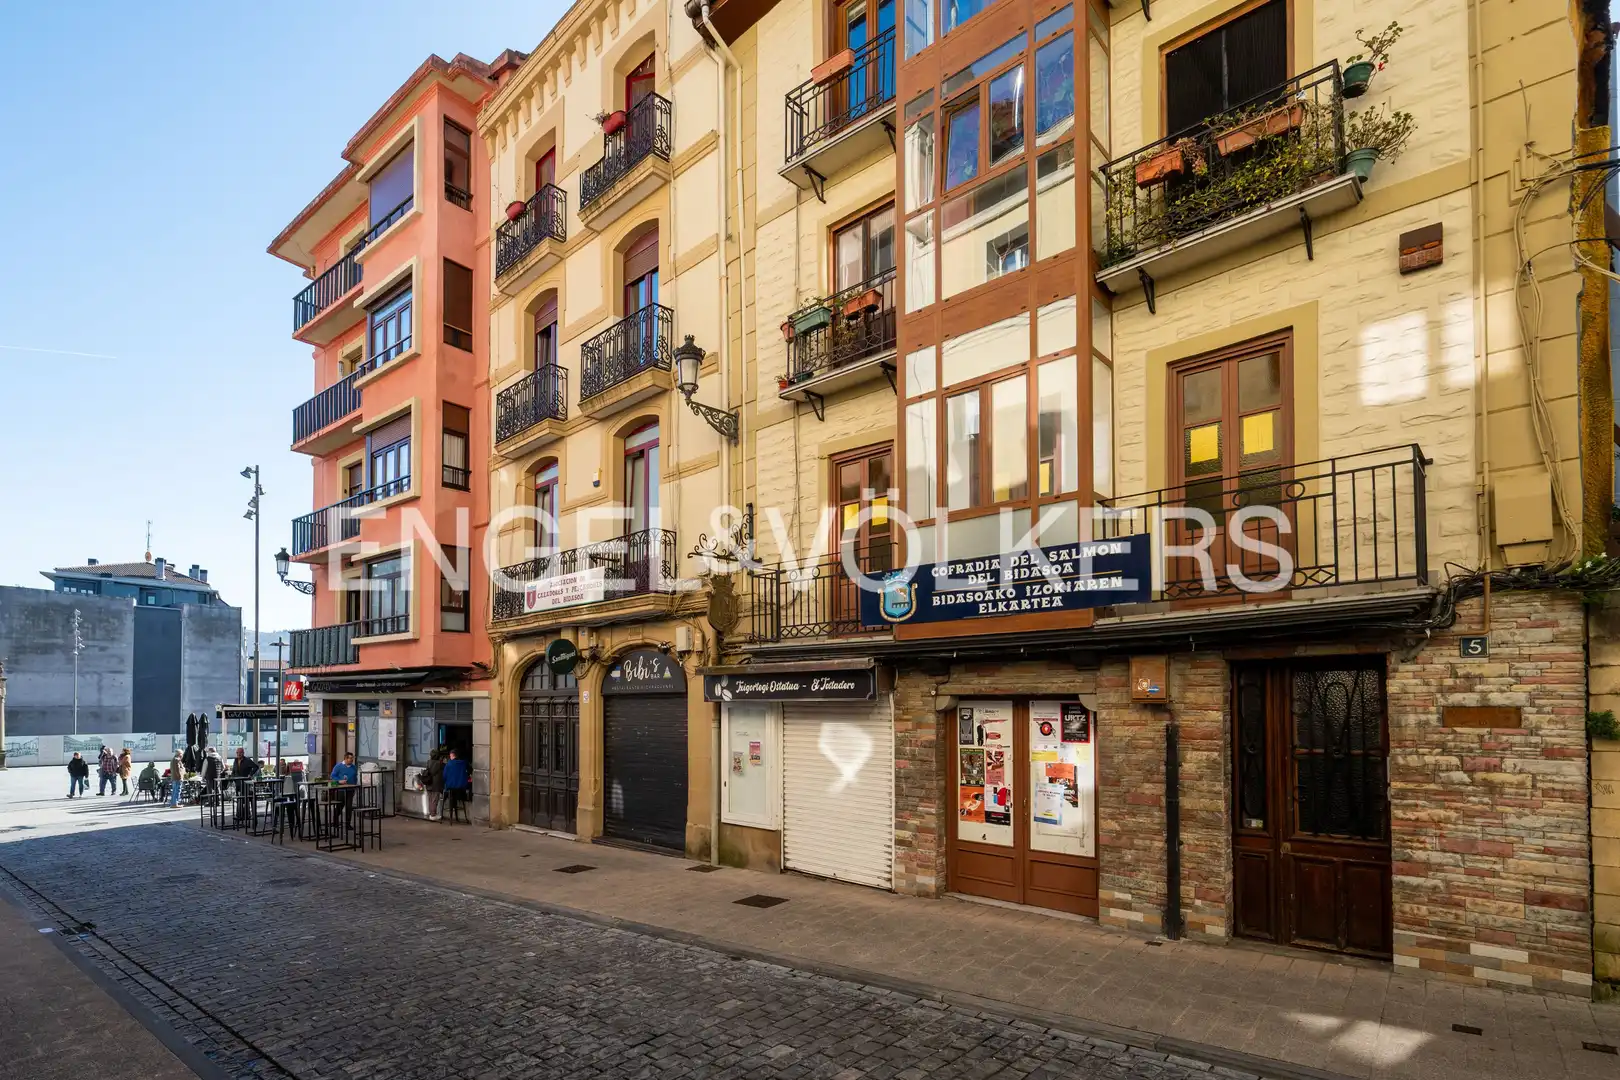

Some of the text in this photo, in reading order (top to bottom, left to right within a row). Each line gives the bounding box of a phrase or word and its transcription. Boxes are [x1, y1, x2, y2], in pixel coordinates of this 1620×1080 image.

[1010, 553, 1040, 567] DEL
[1049, 543, 1122, 562] SALMON
[968, 562, 1073, 585] DEL BIDASOA
[550, 576, 578, 588] AOCIACION
[571, 581, 603, 593] PECADOES
[932, 576, 1123, 606] BIDASOAKO IZOKIAREN
[552, 597, 561, 606] DEL
[978, 596, 1064, 614] ELKARTEA
[1467, 639, 1483, 654] 5
[284, 684, 300, 696] illy
[770, 680, 800, 692] Ostatua
[820, 677, 856, 691] Tostadero
[1064, 714, 1087, 722] URTZ
